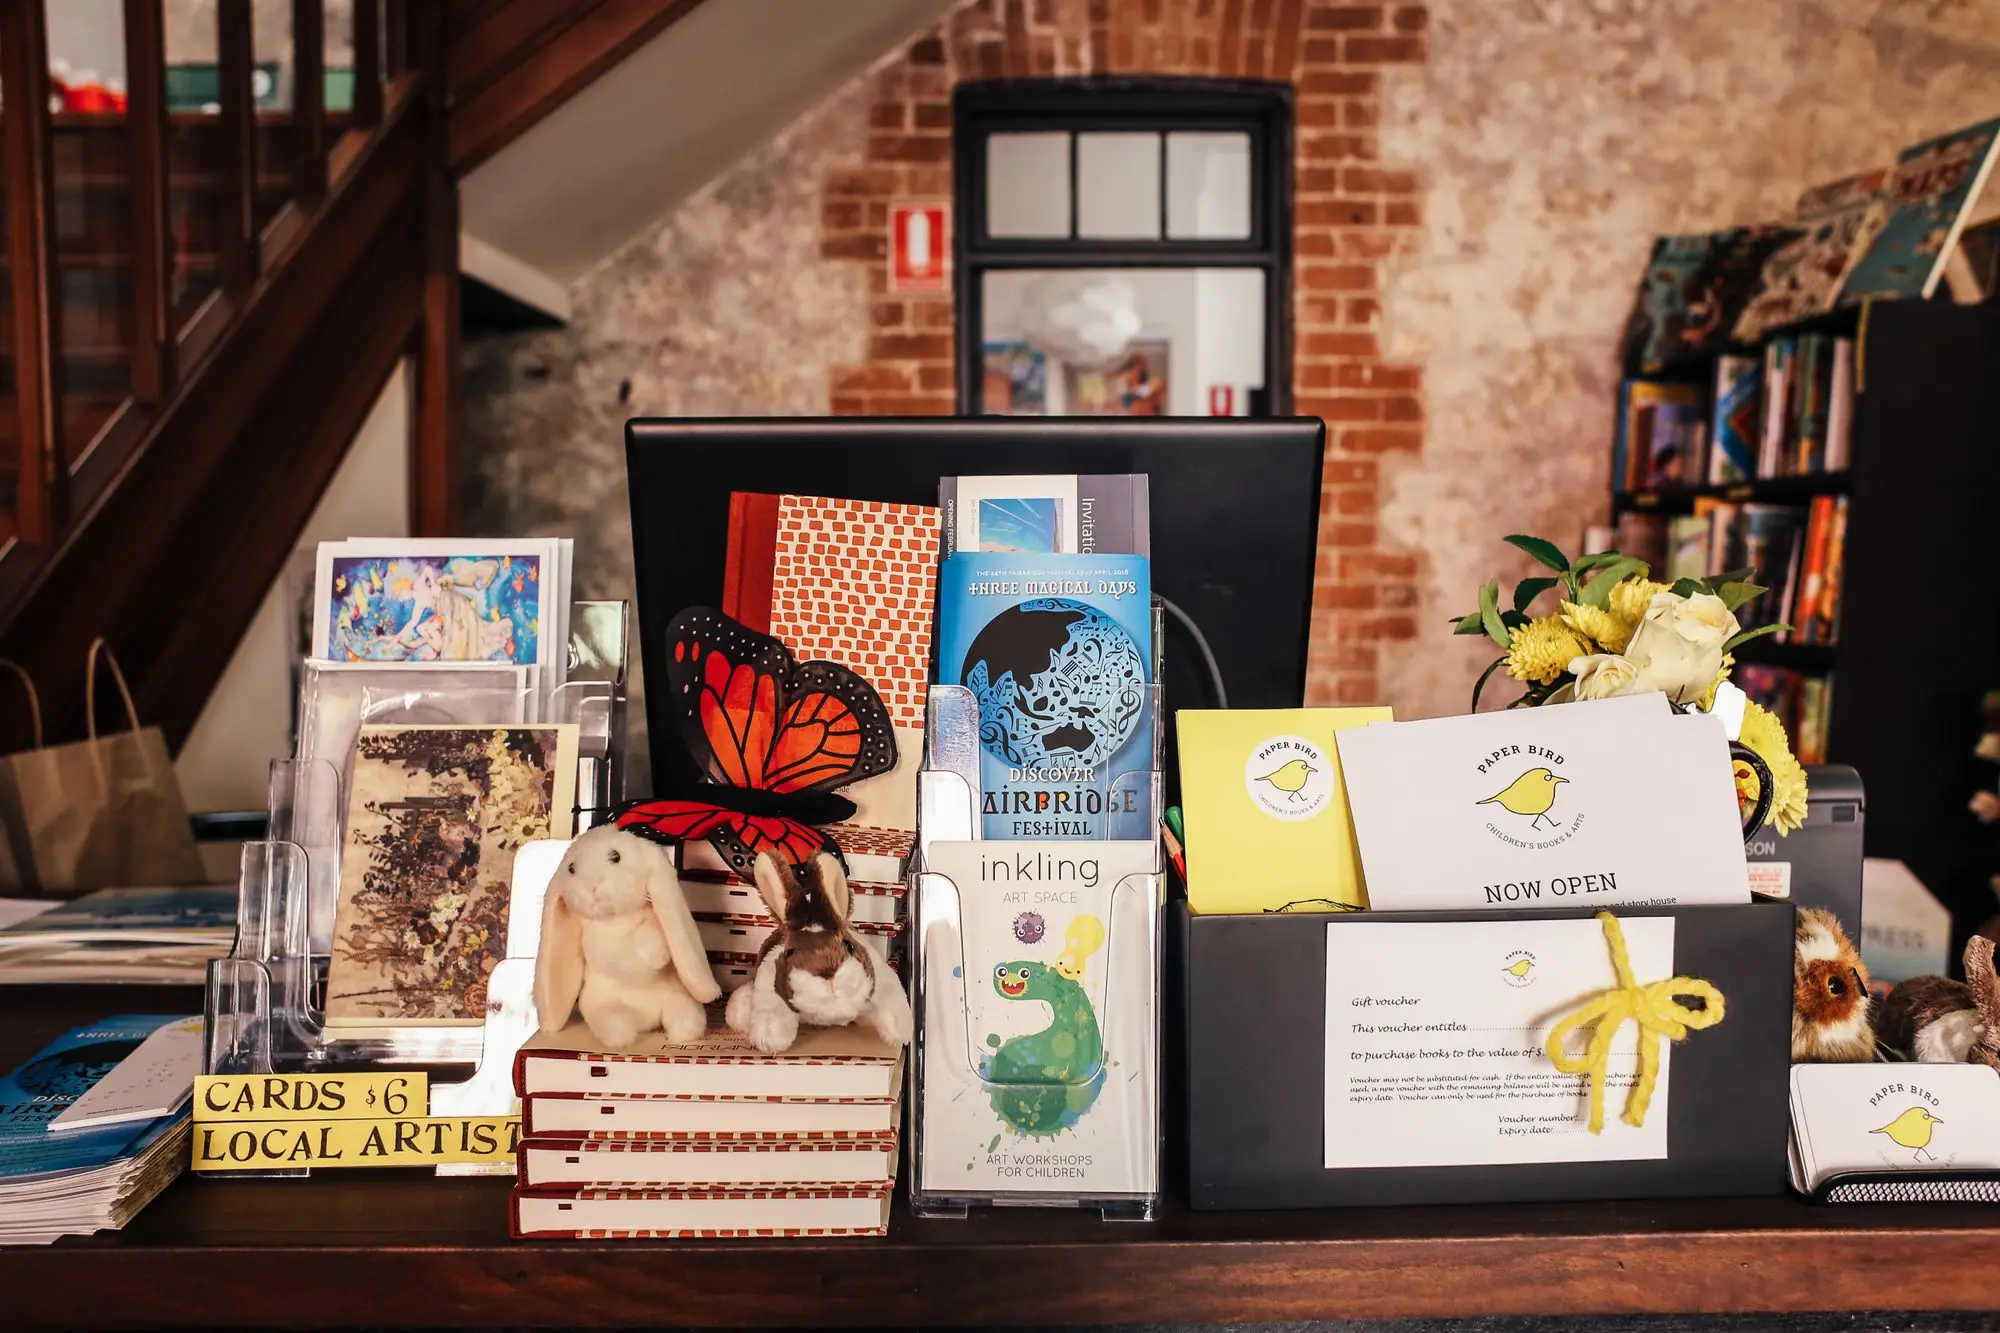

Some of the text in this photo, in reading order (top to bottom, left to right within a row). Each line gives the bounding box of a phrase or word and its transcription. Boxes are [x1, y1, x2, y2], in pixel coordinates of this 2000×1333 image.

[1082, 498, 1096, 554] Invitatio
[969, 579, 1137, 600] THREE MAGICAL DAYS
[1259, 741, 1318, 760] PAPER BIRD
[1477, 745, 1565, 774] PAPER BIRD
[1009, 765, 1097, 783] DISCOVER
[982, 784, 1138, 815] AIRBRIDGE
[1012, 818, 1092, 836] FESTIVAL
[1486, 822, 1535, 849] CHILDREN'S
[1537, 835, 1566, 850] BOOKS
[1571, 812, 1585, 833] ARTS
[1745, 841, 1776, 857] SON
[981, 852, 1099, 887] inkling
[1484, 872, 1618, 904] NOW OPEN
[1003, 891, 1078, 904] ART SPACE
[1650, 897, 1677, 906] house
[1351, 996, 1421, 1008] Gift voucher
[1352, 1022, 1467, 1034] This voucher entitles
[1351, 1051, 1363, 1060] to
[1364, 1050, 1416, 1063] purchase
[1419, 1049, 1450, 1059] books
[1452, 1049, 1464, 1058] to
[1467, 1047, 1486, 1058] the
[1488, 1047, 1520, 1057] value
[1522, 1046, 1536, 1058] of
[1349, 1076, 1381, 1084] Voucher
[1383, 1077, 1399, 1085] may
[1426, 1074, 1467, 1083] substituted
[1469, 1074, 1480, 1082] for
[1396, 1084, 1426, 1092] voucher
[1428, 1083, 1445, 1091] with
[1446, 1083, 1459, 1091] the
[1460, 1083, 1501, 1091] remaining
[1535, 1081, 1550, 1089] will
[32, 1094, 80, 1102] DISC
[205, 1077, 409, 1115] CARDS $6
[1349, 1095, 1374, 1104] expiry
[1398, 1093, 1429, 1101] Voucher
[1447, 1092, 1464, 1101] only
[1495, 1091, 1505, 1100] for
[1508, 1091, 1520, 1099] the
[1521, 1090, 1556, 1100] purchase
[1557, 1090, 1565, 1099] of
[1868, 1083, 1940, 1107] PAPER BIRD
[1498, 1113, 1536, 1123] Voucher
[1499, 1126, 1527, 1136] Expiry
[200, 1120, 523, 1163] LOCAL ARTIST
[986, 1154, 1093, 1165] ART WORKSHOPS
[997, 1167, 1085, 1178] FOR CHILDREN
